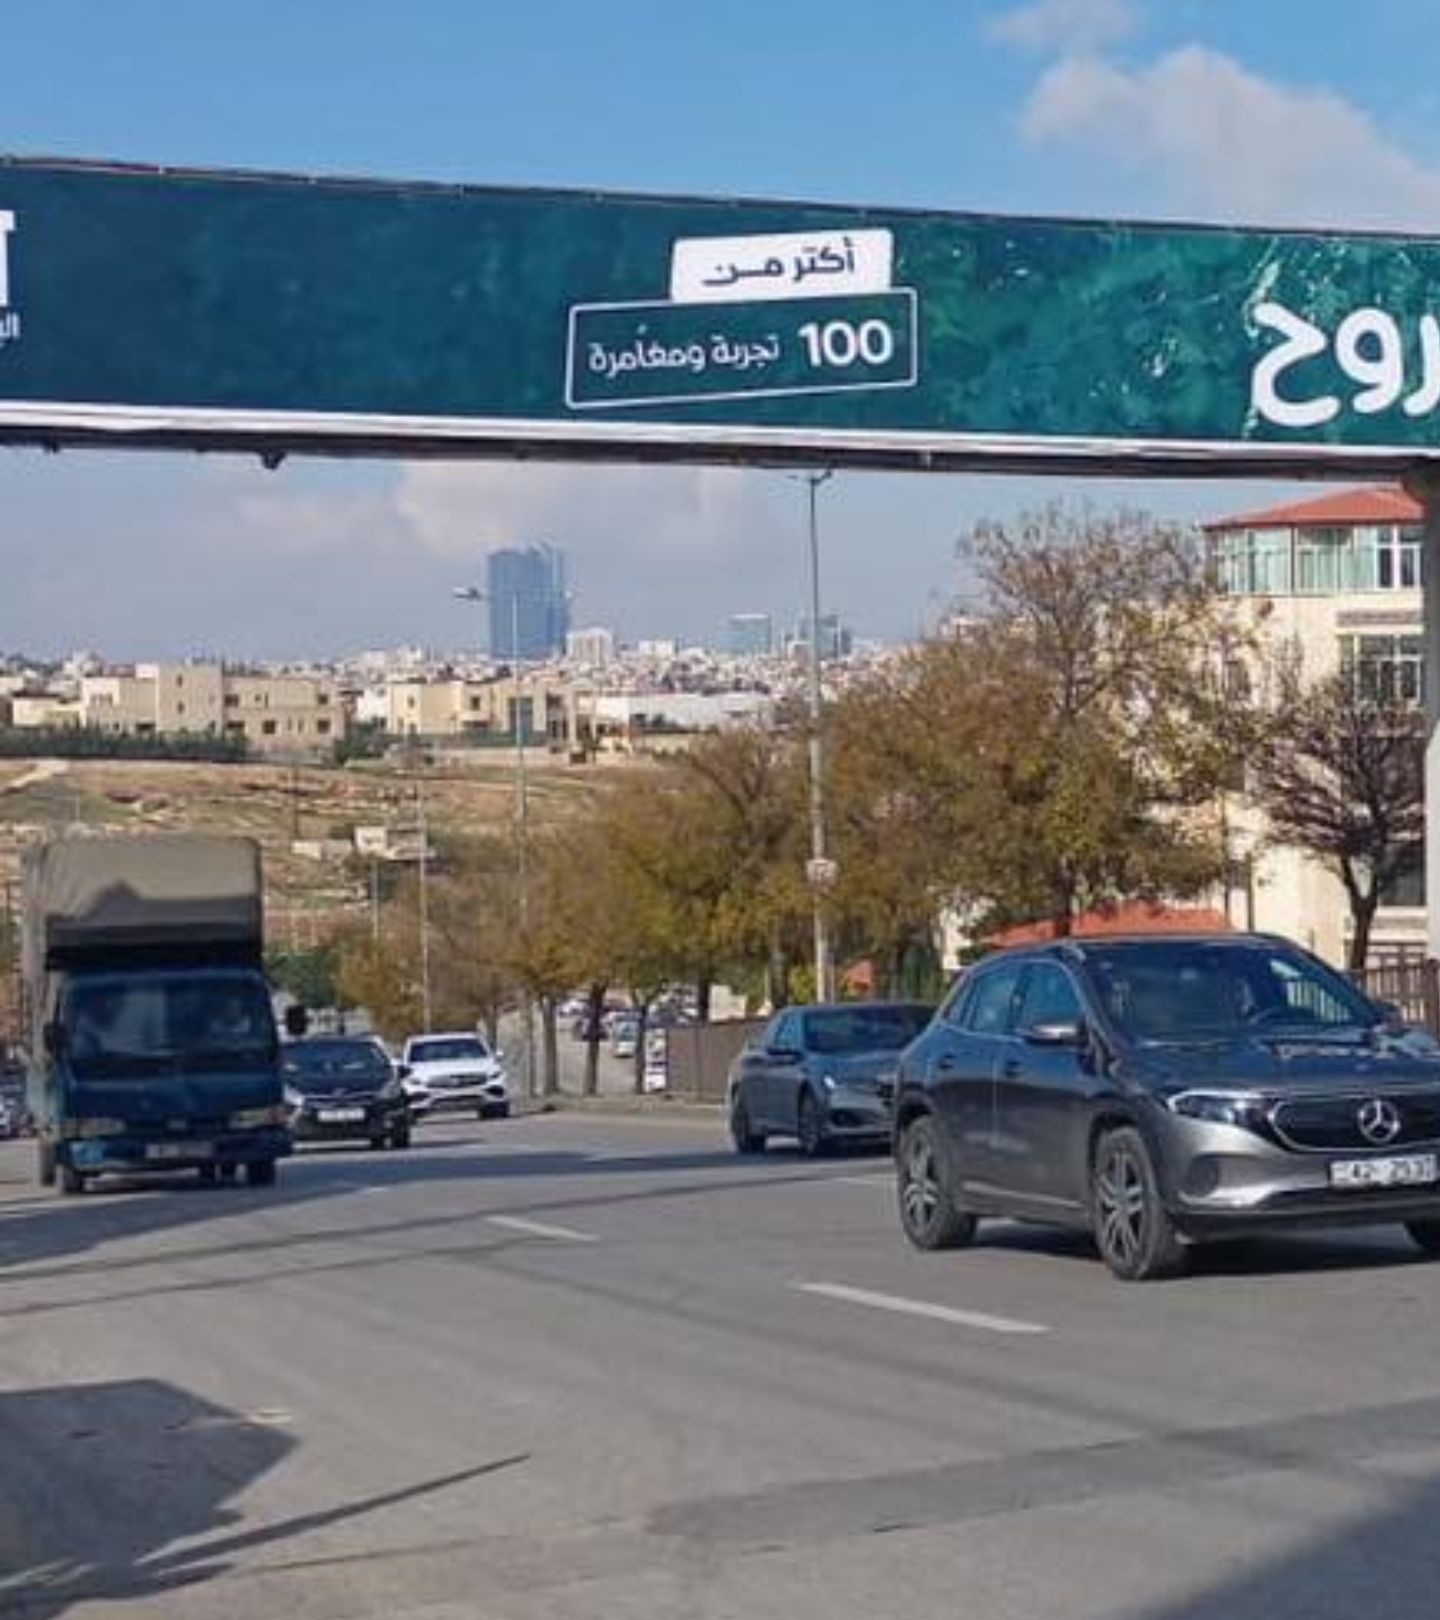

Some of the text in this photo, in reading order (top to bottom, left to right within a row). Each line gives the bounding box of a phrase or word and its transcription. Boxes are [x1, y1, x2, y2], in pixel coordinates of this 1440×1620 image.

[703, 236, 856, 287] أكتر من
[588, 319, 893, 378] 100 تجربة ومغامرة
